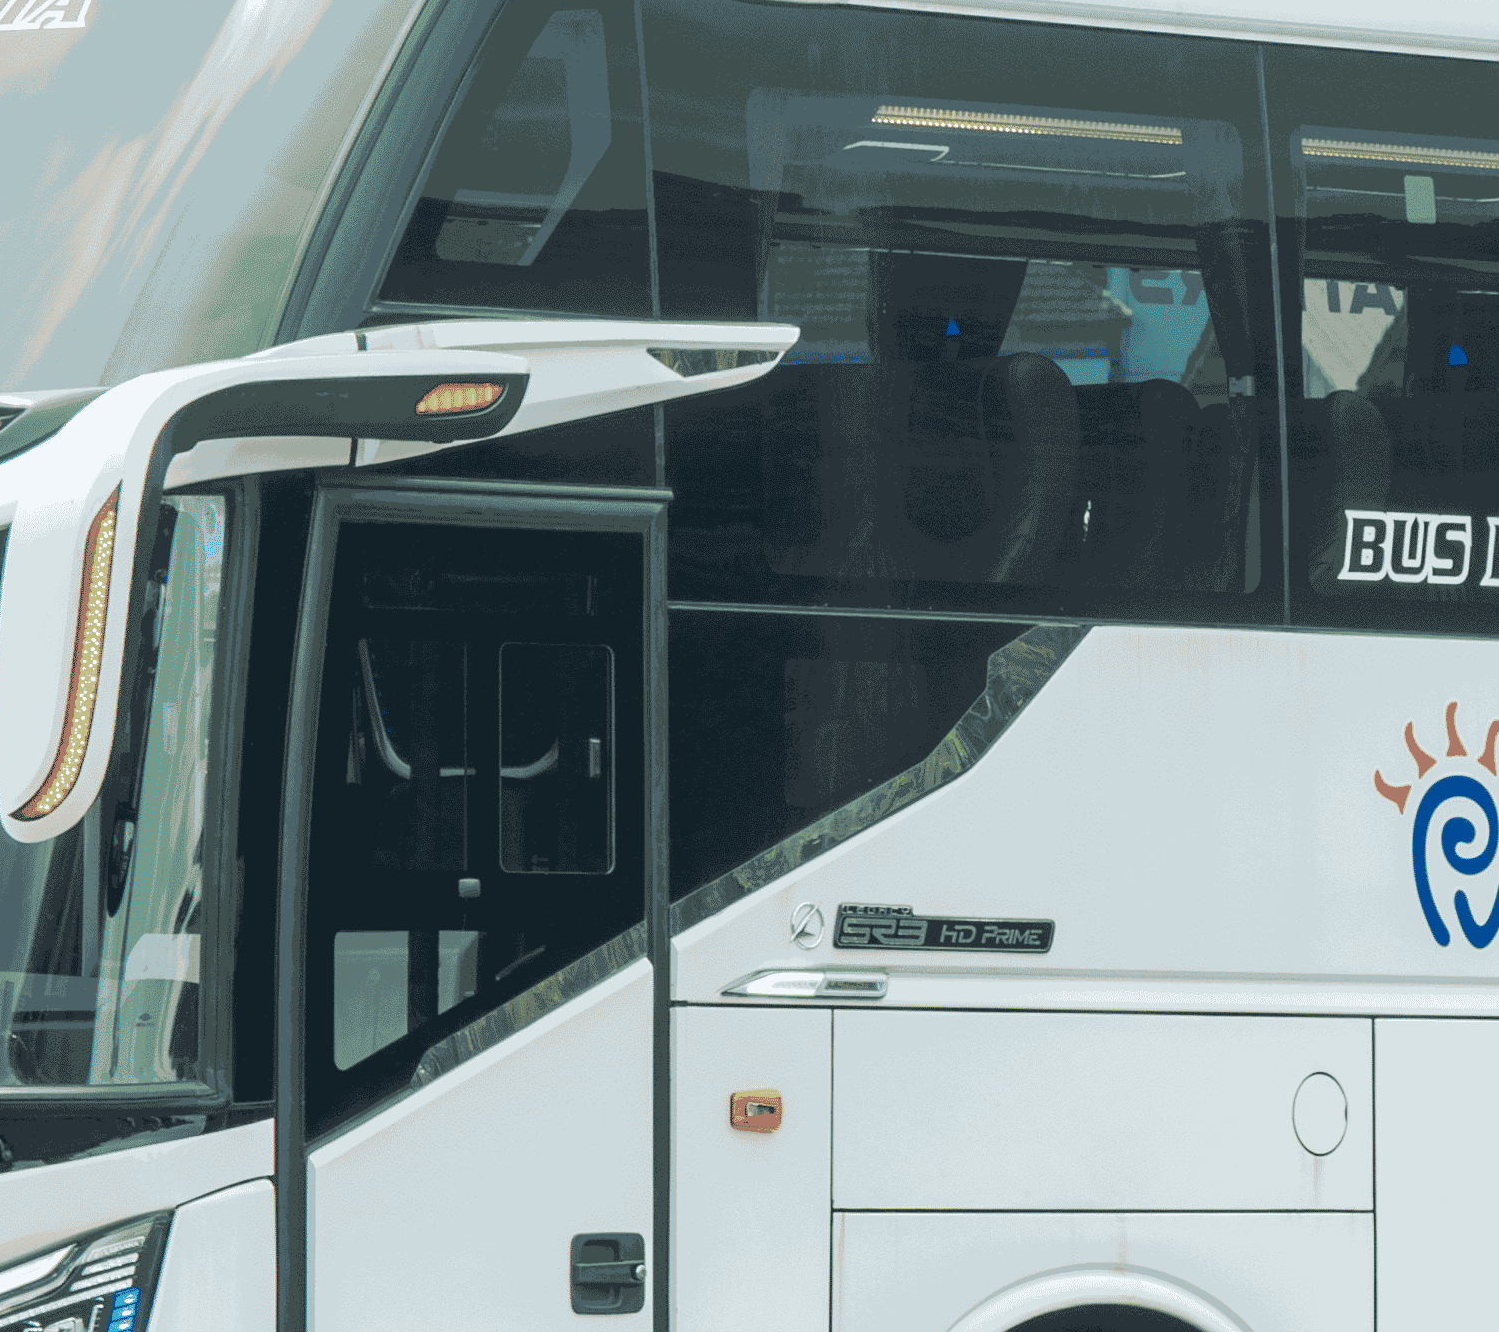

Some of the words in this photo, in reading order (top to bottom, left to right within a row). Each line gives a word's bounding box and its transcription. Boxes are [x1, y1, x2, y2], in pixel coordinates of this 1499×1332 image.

[1338, 510, 1472, 584] BUS
[939, 924, 977, 944] HD
[981, 925, 1044, 946] PRIME
